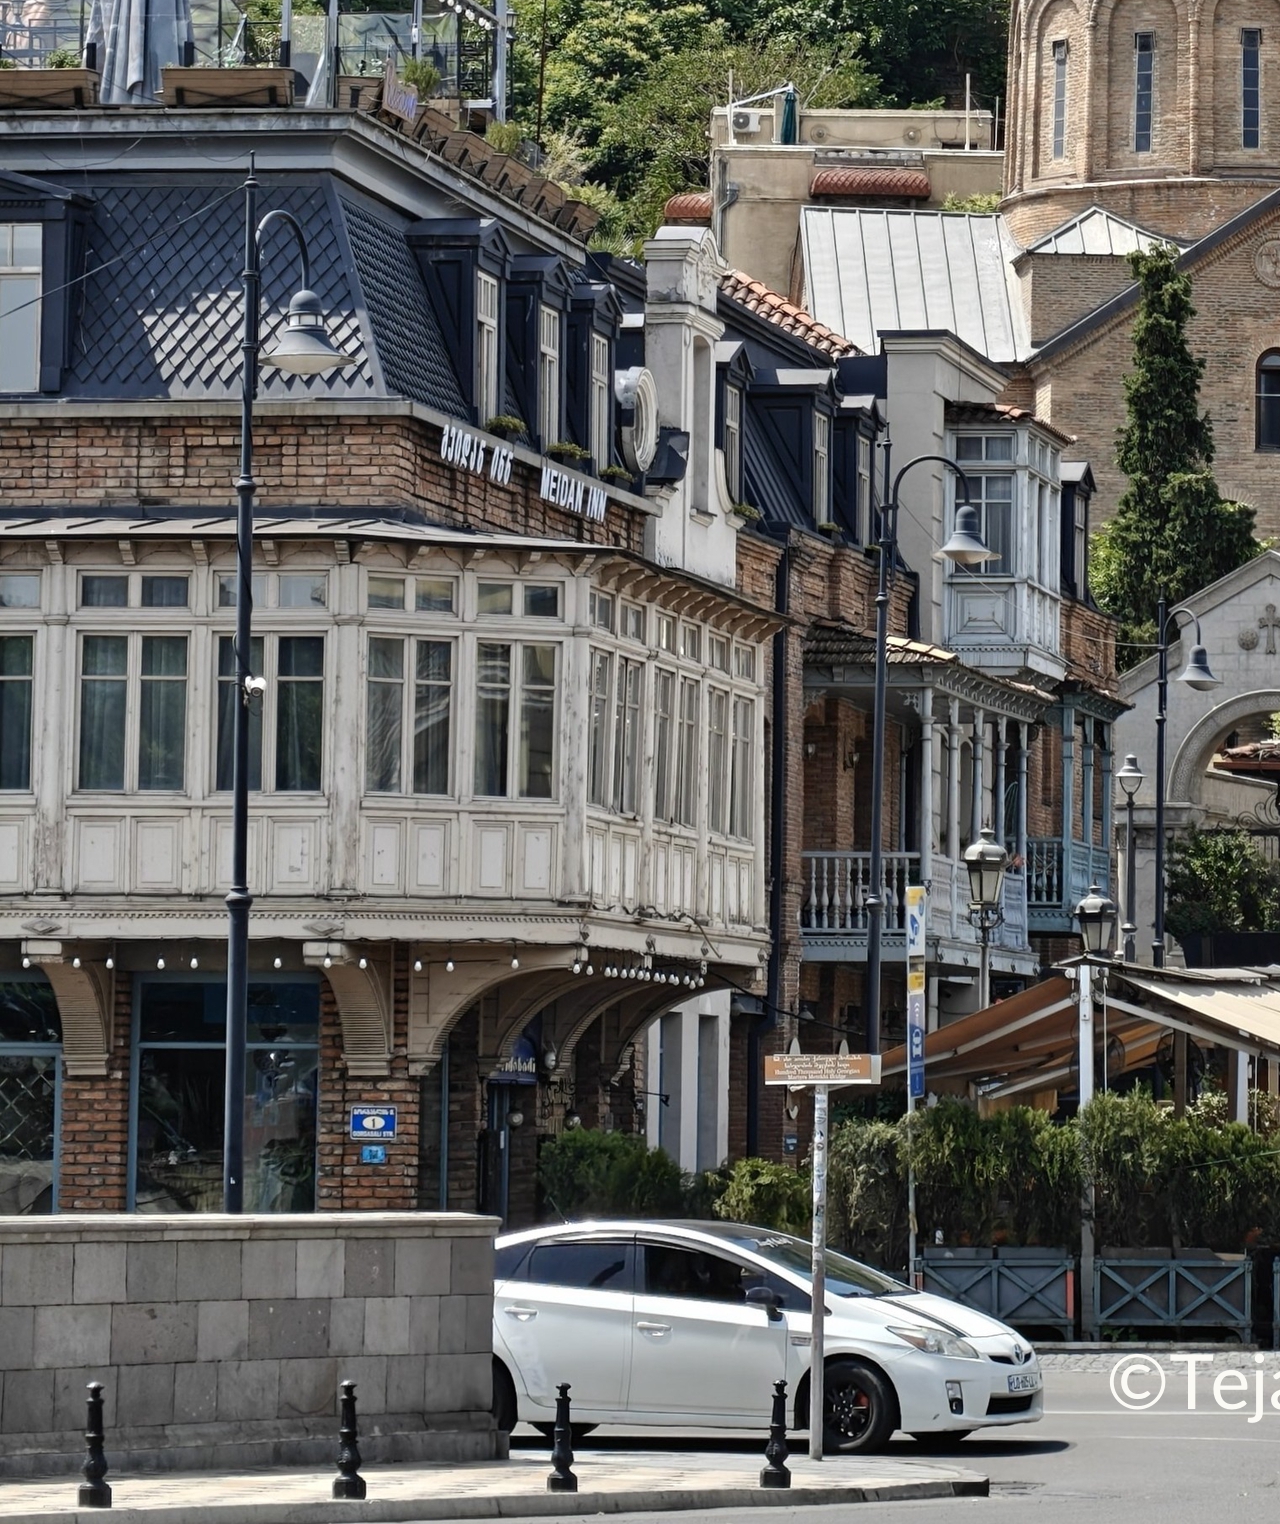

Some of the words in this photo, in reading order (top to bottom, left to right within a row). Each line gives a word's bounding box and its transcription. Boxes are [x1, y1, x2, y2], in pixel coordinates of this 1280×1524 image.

[440, 424, 487, 475] მეიდან
[490, 446, 514, 486] ინნ
[539, 465, 585, 514] MEIDAN
[586, 486, 608, 523] INN
[372, 1118, 376, 1128] 1
